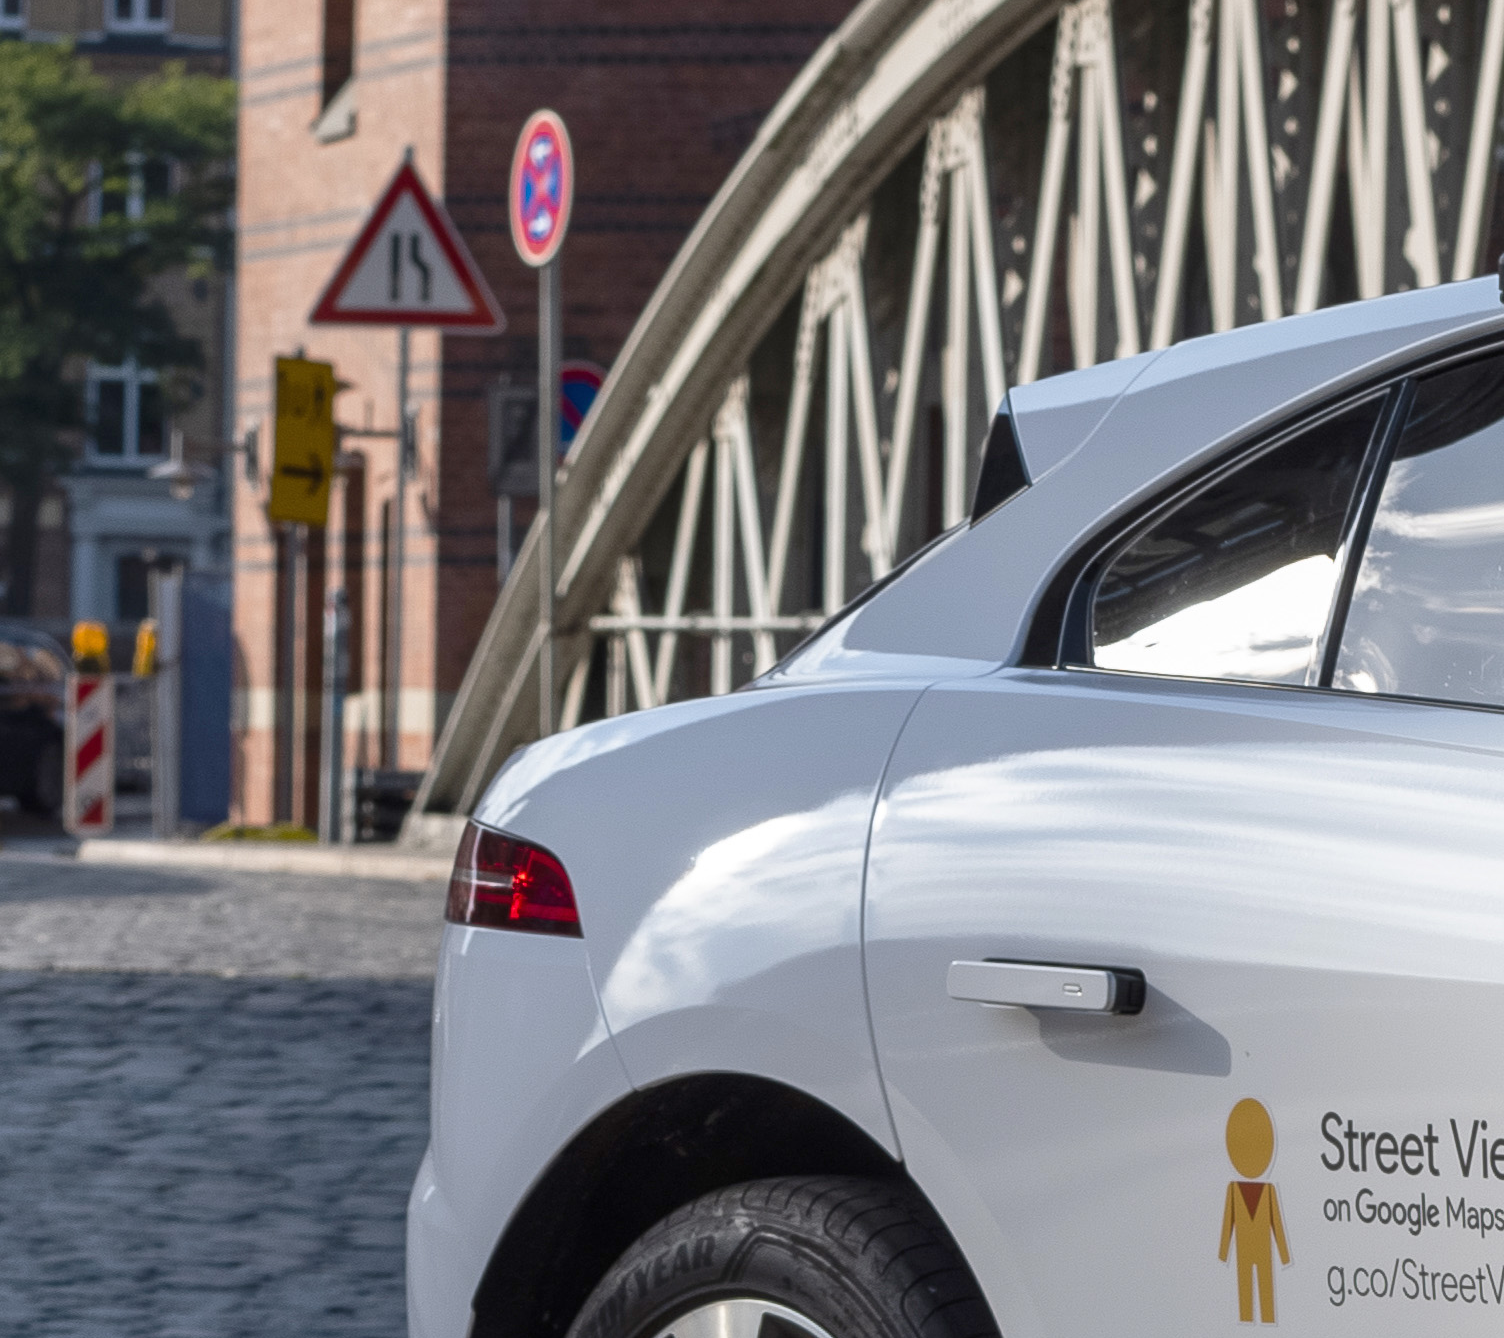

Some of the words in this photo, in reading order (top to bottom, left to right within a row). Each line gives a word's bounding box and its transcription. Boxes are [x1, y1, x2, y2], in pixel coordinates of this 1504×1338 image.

[1320, 1111, 1440, 1178] Street
[1323, 1197, 1351, 1222] on
[1355, 1188, 1440, 1237] Google
